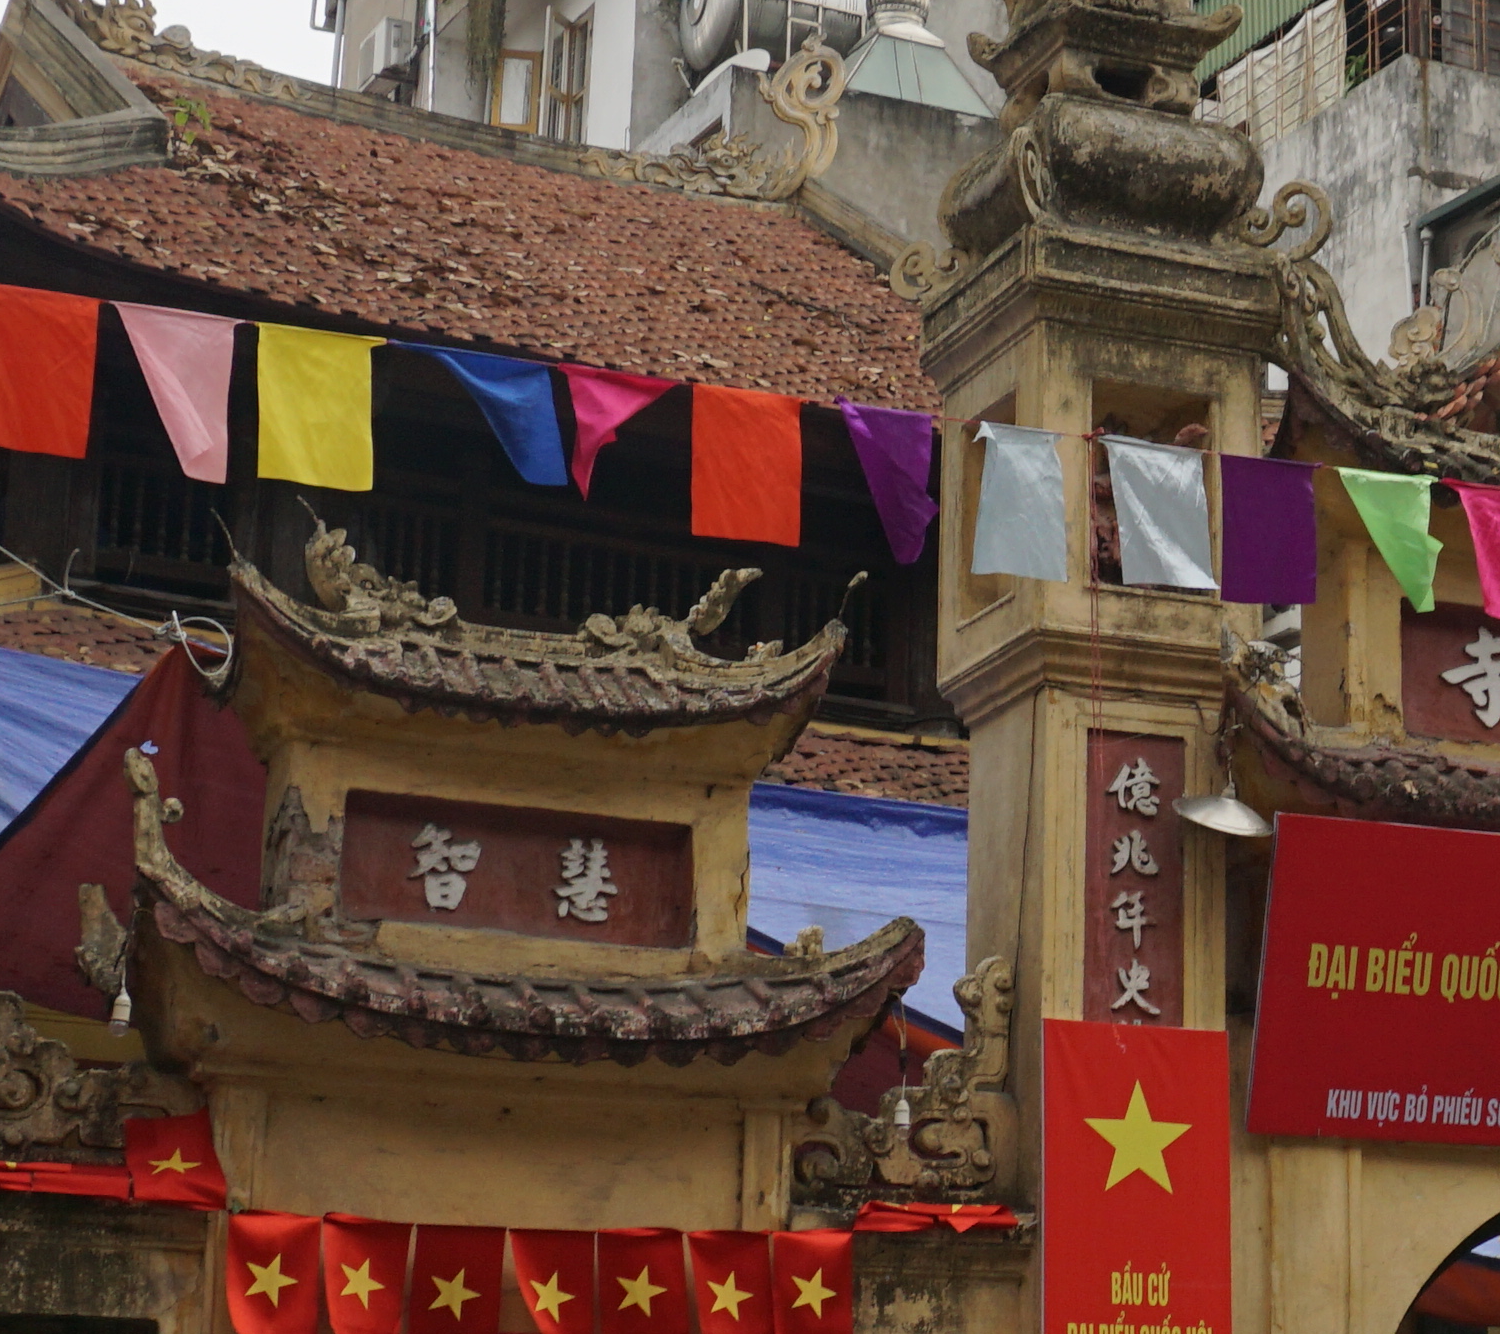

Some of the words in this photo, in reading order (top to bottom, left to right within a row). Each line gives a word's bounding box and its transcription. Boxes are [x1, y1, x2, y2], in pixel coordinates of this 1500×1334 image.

[1307, 943, 1359, 1000] ĐẠI
[1365, 932, 1431, 996] BIỂU
[1326, 1089, 1363, 1119] KHU
[1367, 1090, 1400, 1127] VỰC
[1404, 1085, 1428, 1123] BỎ
[1431, 1089, 1483, 1126] PHIẾU
[1111, 1260, 1143, 1306] BẦU
[1147, 1261, 1171, 1307] CỬ
